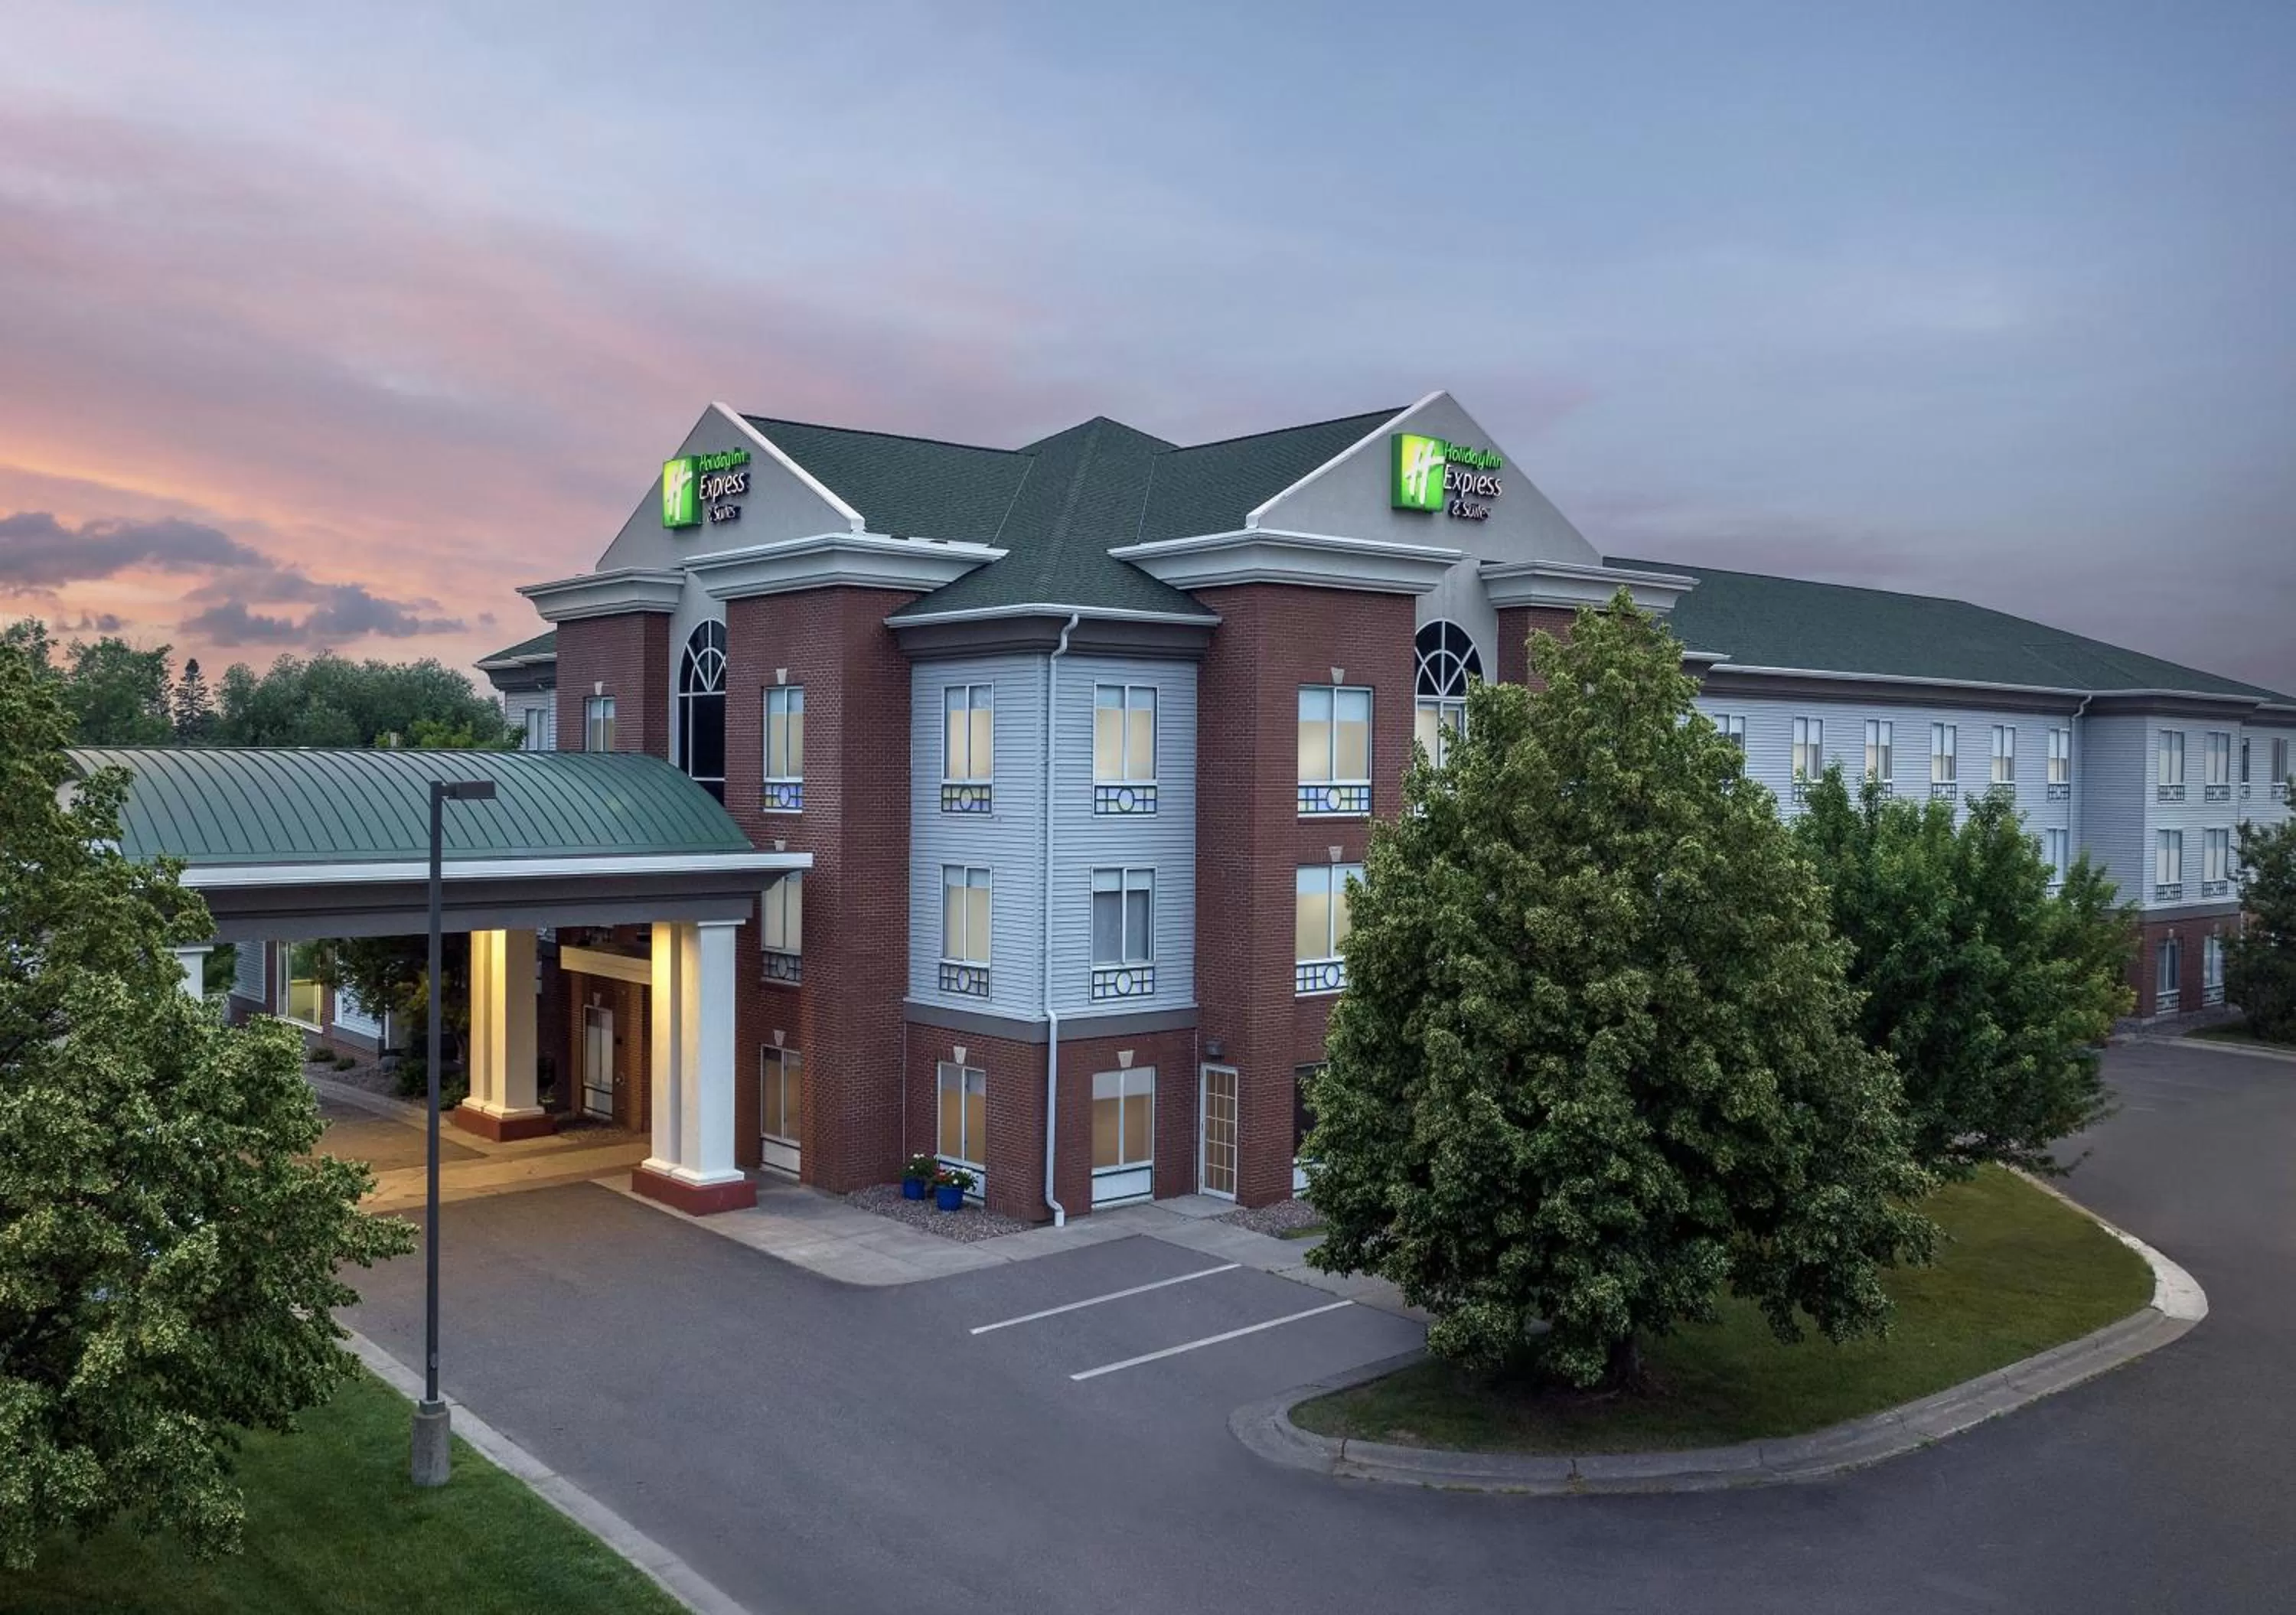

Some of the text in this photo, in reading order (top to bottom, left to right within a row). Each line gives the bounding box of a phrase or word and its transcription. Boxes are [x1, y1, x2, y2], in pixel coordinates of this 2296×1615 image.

[1444, 442, 1486, 471] Holiday
[699, 472, 745, 503] Express
[1443, 464, 1503, 498] Express
